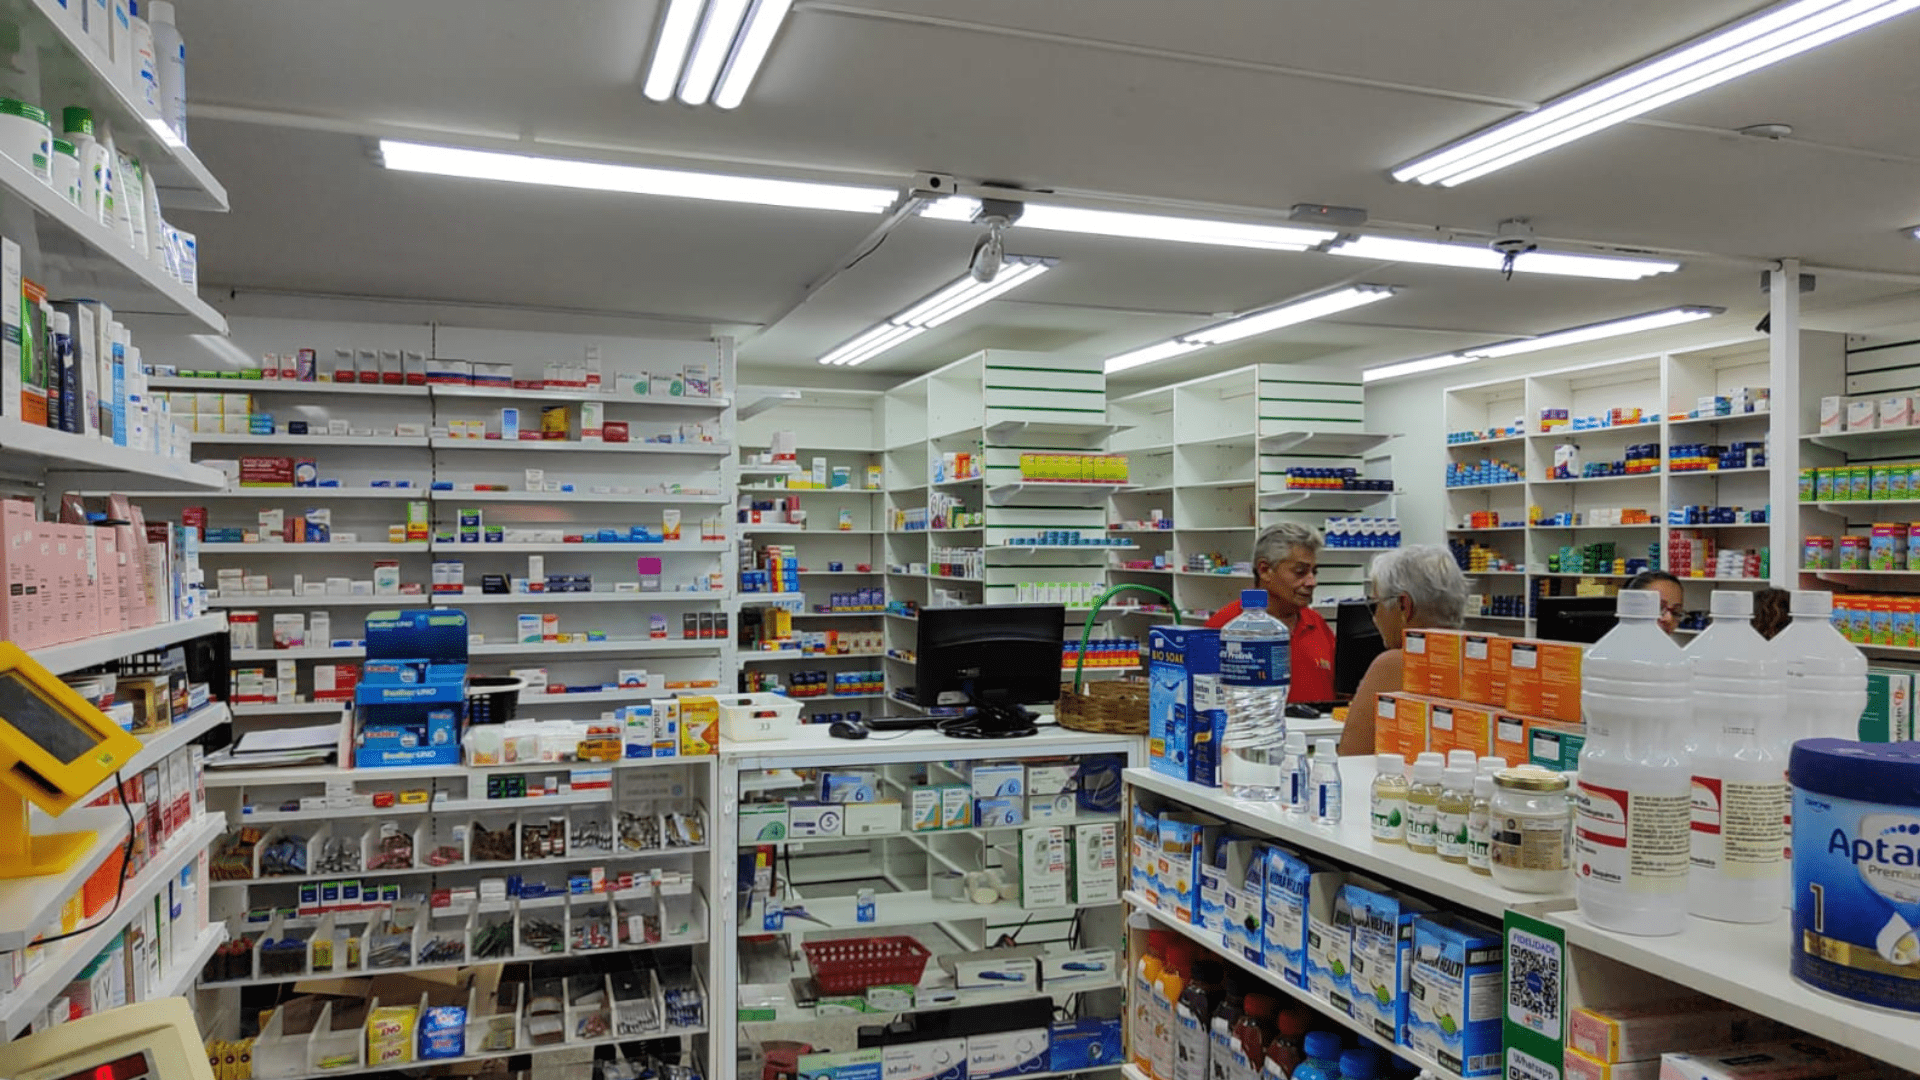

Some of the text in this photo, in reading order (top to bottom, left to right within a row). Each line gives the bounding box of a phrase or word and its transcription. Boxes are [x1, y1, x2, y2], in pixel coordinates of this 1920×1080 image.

[1151, 650, 1184, 664] BIO SOAK
[1007, 780, 1016, 793] 6
[855, 789, 864, 801] 6
[825, 816, 834, 828] 5
[1004, 809, 1014, 824] 6
[772, 825, 779, 836] 4
[1810, 882, 1824, 933] 1
[1513, 932, 1556, 955] FIDELIDADE
[1513, 1052, 1554, 1080] Whatsapp
